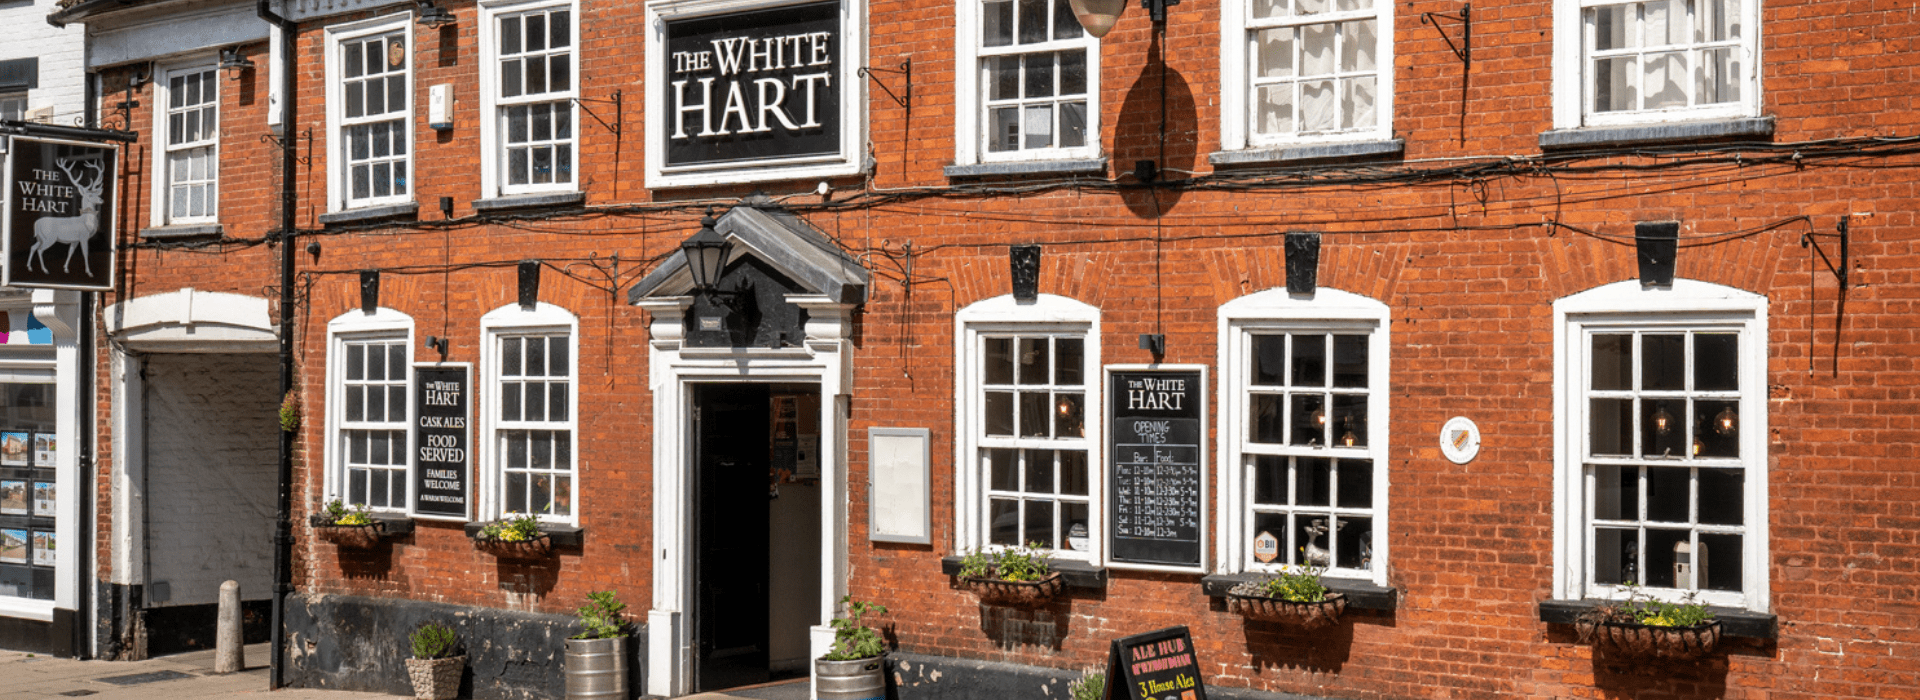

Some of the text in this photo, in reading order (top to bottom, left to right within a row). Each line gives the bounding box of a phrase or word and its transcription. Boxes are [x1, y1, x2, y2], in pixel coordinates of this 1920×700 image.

[672, 31, 832, 76] THE WHITE
[671, 71, 832, 139] HART
[32, 168, 60, 181] THE
[18, 180, 74, 198] WHITE
[22, 197, 69, 214] HART
[434, 380, 460, 391] WHITE
[1128, 378, 1186, 391] THE WHITE
[425, 390, 460, 406] HART
[1128, 389, 1186, 411] HART
[420, 415, 465, 428] CASK ALES
[1133, 420, 1171, 433] OPENING
[427, 434, 457, 448] FOOD
[1137, 432, 1167, 443] TIMES
[420, 446, 465, 463] SERVED
[1156, 450, 1175, 463] Food:
[426, 468, 458, 480] FAMILIES
[423, 478, 461, 490] WELCOME
[1132, 638, 1186, 662] ALE HUB
[1138, 673, 1195, 698] 3 House Ales
